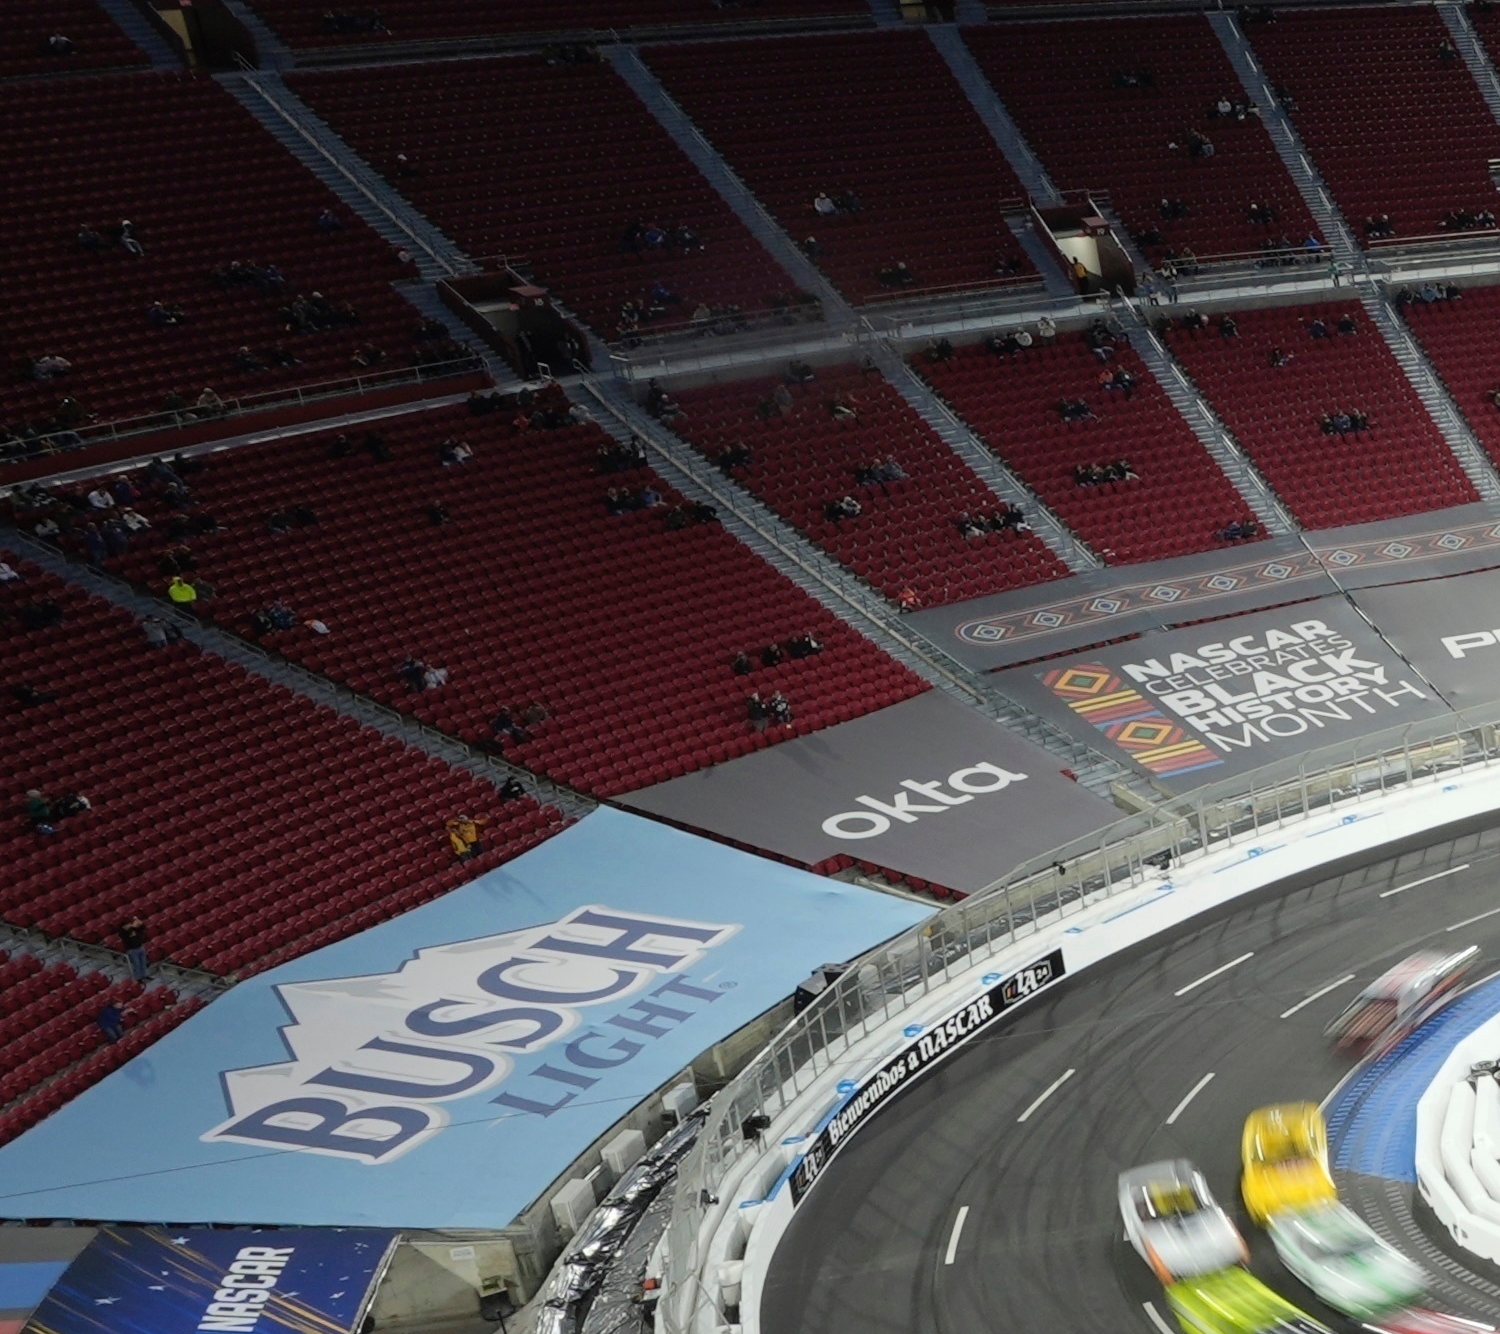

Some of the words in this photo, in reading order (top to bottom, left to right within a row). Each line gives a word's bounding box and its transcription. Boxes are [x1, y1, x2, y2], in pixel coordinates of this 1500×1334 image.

[1120, 618, 1333, 685] NASCAR
[1144, 632, 1354, 697] CELEBRATES
[1160, 647, 1386, 721] BLACK
[1185, 671, 1391, 735] HISTORY
[1203, 678, 1431, 754] MONTH
[820, 761, 1029, 841] okta
[207, 907, 733, 1163] BUSCH
[487, 972, 726, 1119] LIGHT
[827, 1060, 907, 1147] Bienvenidos
[907, 1056, 920, 1072] a
[917, 993, 994, 1063] NASCAR
[198, 1244, 296, 1334] NASCAR
